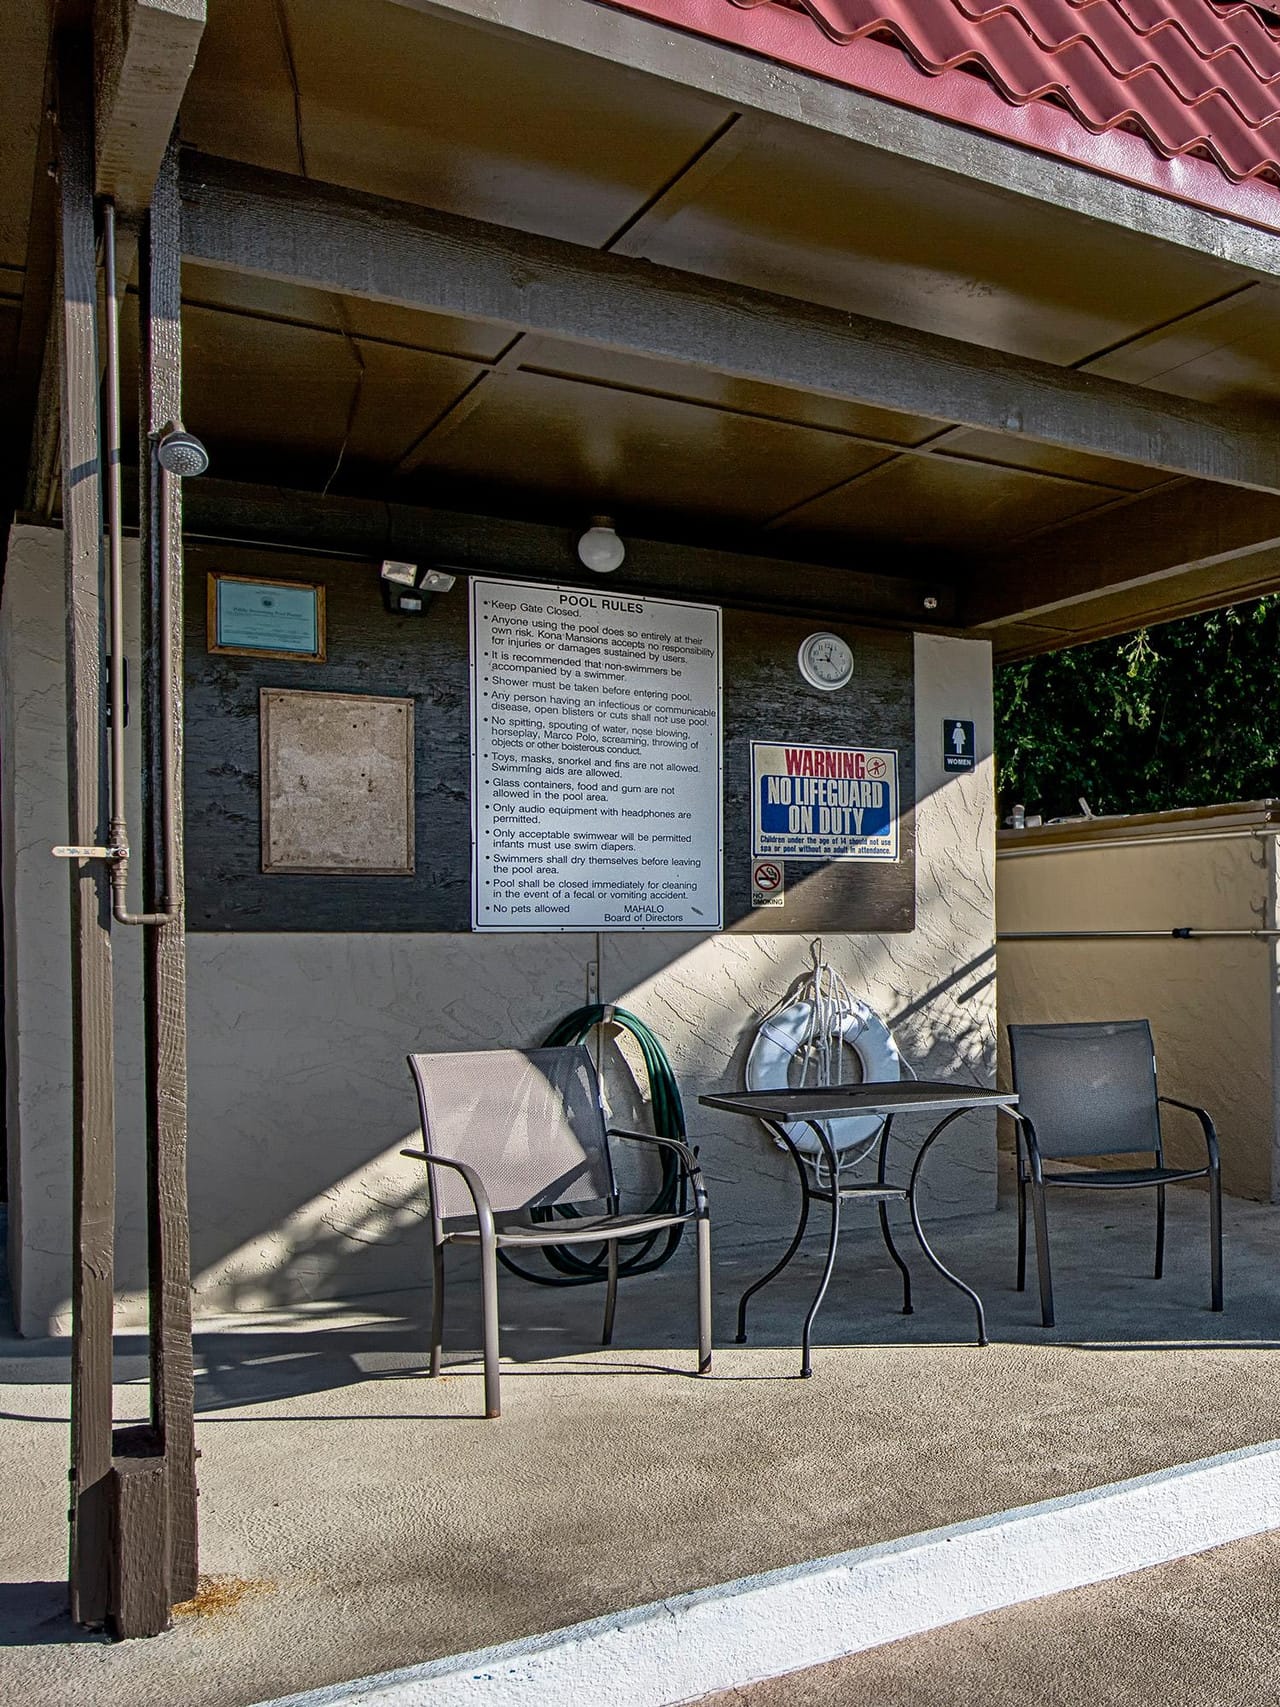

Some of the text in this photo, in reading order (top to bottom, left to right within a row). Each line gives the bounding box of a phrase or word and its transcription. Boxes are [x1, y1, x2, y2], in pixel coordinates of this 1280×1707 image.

[491, 599, 581, 618] Keep Gate Closed.
[559, 595, 643, 613] POOL RULES
[490, 614, 702, 645] Anyone using the pool does so entirely at their
[491, 626, 512, 635] own
[515, 627, 533, 637] risk.
[537, 629, 562, 640] Kona
[565, 632, 608, 645] Mansions
[611, 637, 645, 651] accepts
[661, 643, 714, 658] responsibility
[491, 635, 687, 663] for injuries or damages sustained by users.
[492, 650, 681, 676] It is recommended that non-swimmers be
[491, 675, 692, 703] Shower must be taken before entering pool.
[490, 690, 510, 702] Any
[513, 694, 546, 705] person
[549, 695, 580, 708] having
[583, 699, 595, 707] an
[598, 699, 640, 710] infectious
[654, 704, 716, 717] communicable
[491, 726, 698, 750] horseplay, Marco Polo, screaming, throwing of
[491, 752, 517, 764] Toys,
[521, 754, 554, 765] masks,
[558, 756, 591, 766] snorkel
[594, 758, 611, 767] and
[614, 759, 629, 768] fins
[649, 761, 663, 770] not
[666, 762, 700, 772] allowed.
[784, 748, 866, 780] WARNING
[946, 757, 972, 766] WOMEN
[491, 762, 622, 778] Swimming aids are allowed.
[492, 777, 520, 787] Glass
[522, 779, 574, 791] containers,
[577, 782, 598, 791] food
[600, 783, 618, 792] and
[620, 786, 641, 795] gum
[660, 786, 675, 795] not
[767, 776, 883, 809] NO LIFEGUARD
[492, 788, 608, 802] allowed in the pool area.
[492, 803, 515, 814] Only
[518, 804, 545, 813] audio
[548, 805, 597, 817] equipment
[600, 807, 618, 816] with
[621, 808, 675, 820] headphones
[492, 814, 541, 826] permitted.
[788, 805, 864, 836] ON DUTY
[493, 828, 691, 844] Only acceptable swimwear will be permitted
[760, 835, 785, 843] Children
[787, 836, 804, 844] under
[807, 836, 817, 844] the
[832, 837, 839, 845] of
[840, 837, 847, 845] 14
[849, 837, 867, 845] should
[869, 838, 879, 846] not
[492, 839, 524, 848] infants
[527, 840, 551, 849] must
[573, 841, 598, 850] swim
[600, 842, 636, 853] diapers.
[492, 853, 701, 868] Swimmers shall dry themselves before leaving
[493, 864, 508, 873] the
[511, 865, 533, 875] pool
[493, 879, 697, 891] Pool shall be closed immediately for cleaning
[492, 889, 502, 898] in
[504, 889, 520, 898] the
[523, 890, 549, 898] event
[551, 890, 561, 898] of
[573, 890, 595, 898] fecal
[609, 890, 647, 901] vomiting
[649, 891, 688, 899] accident.
[752, 898, 783, 906] SMOKING
[493, 904, 569, 914] No pets allowed
[604, 913, 683, 921] Board of Directors
[623, 905, 664, 913] MAHALO
